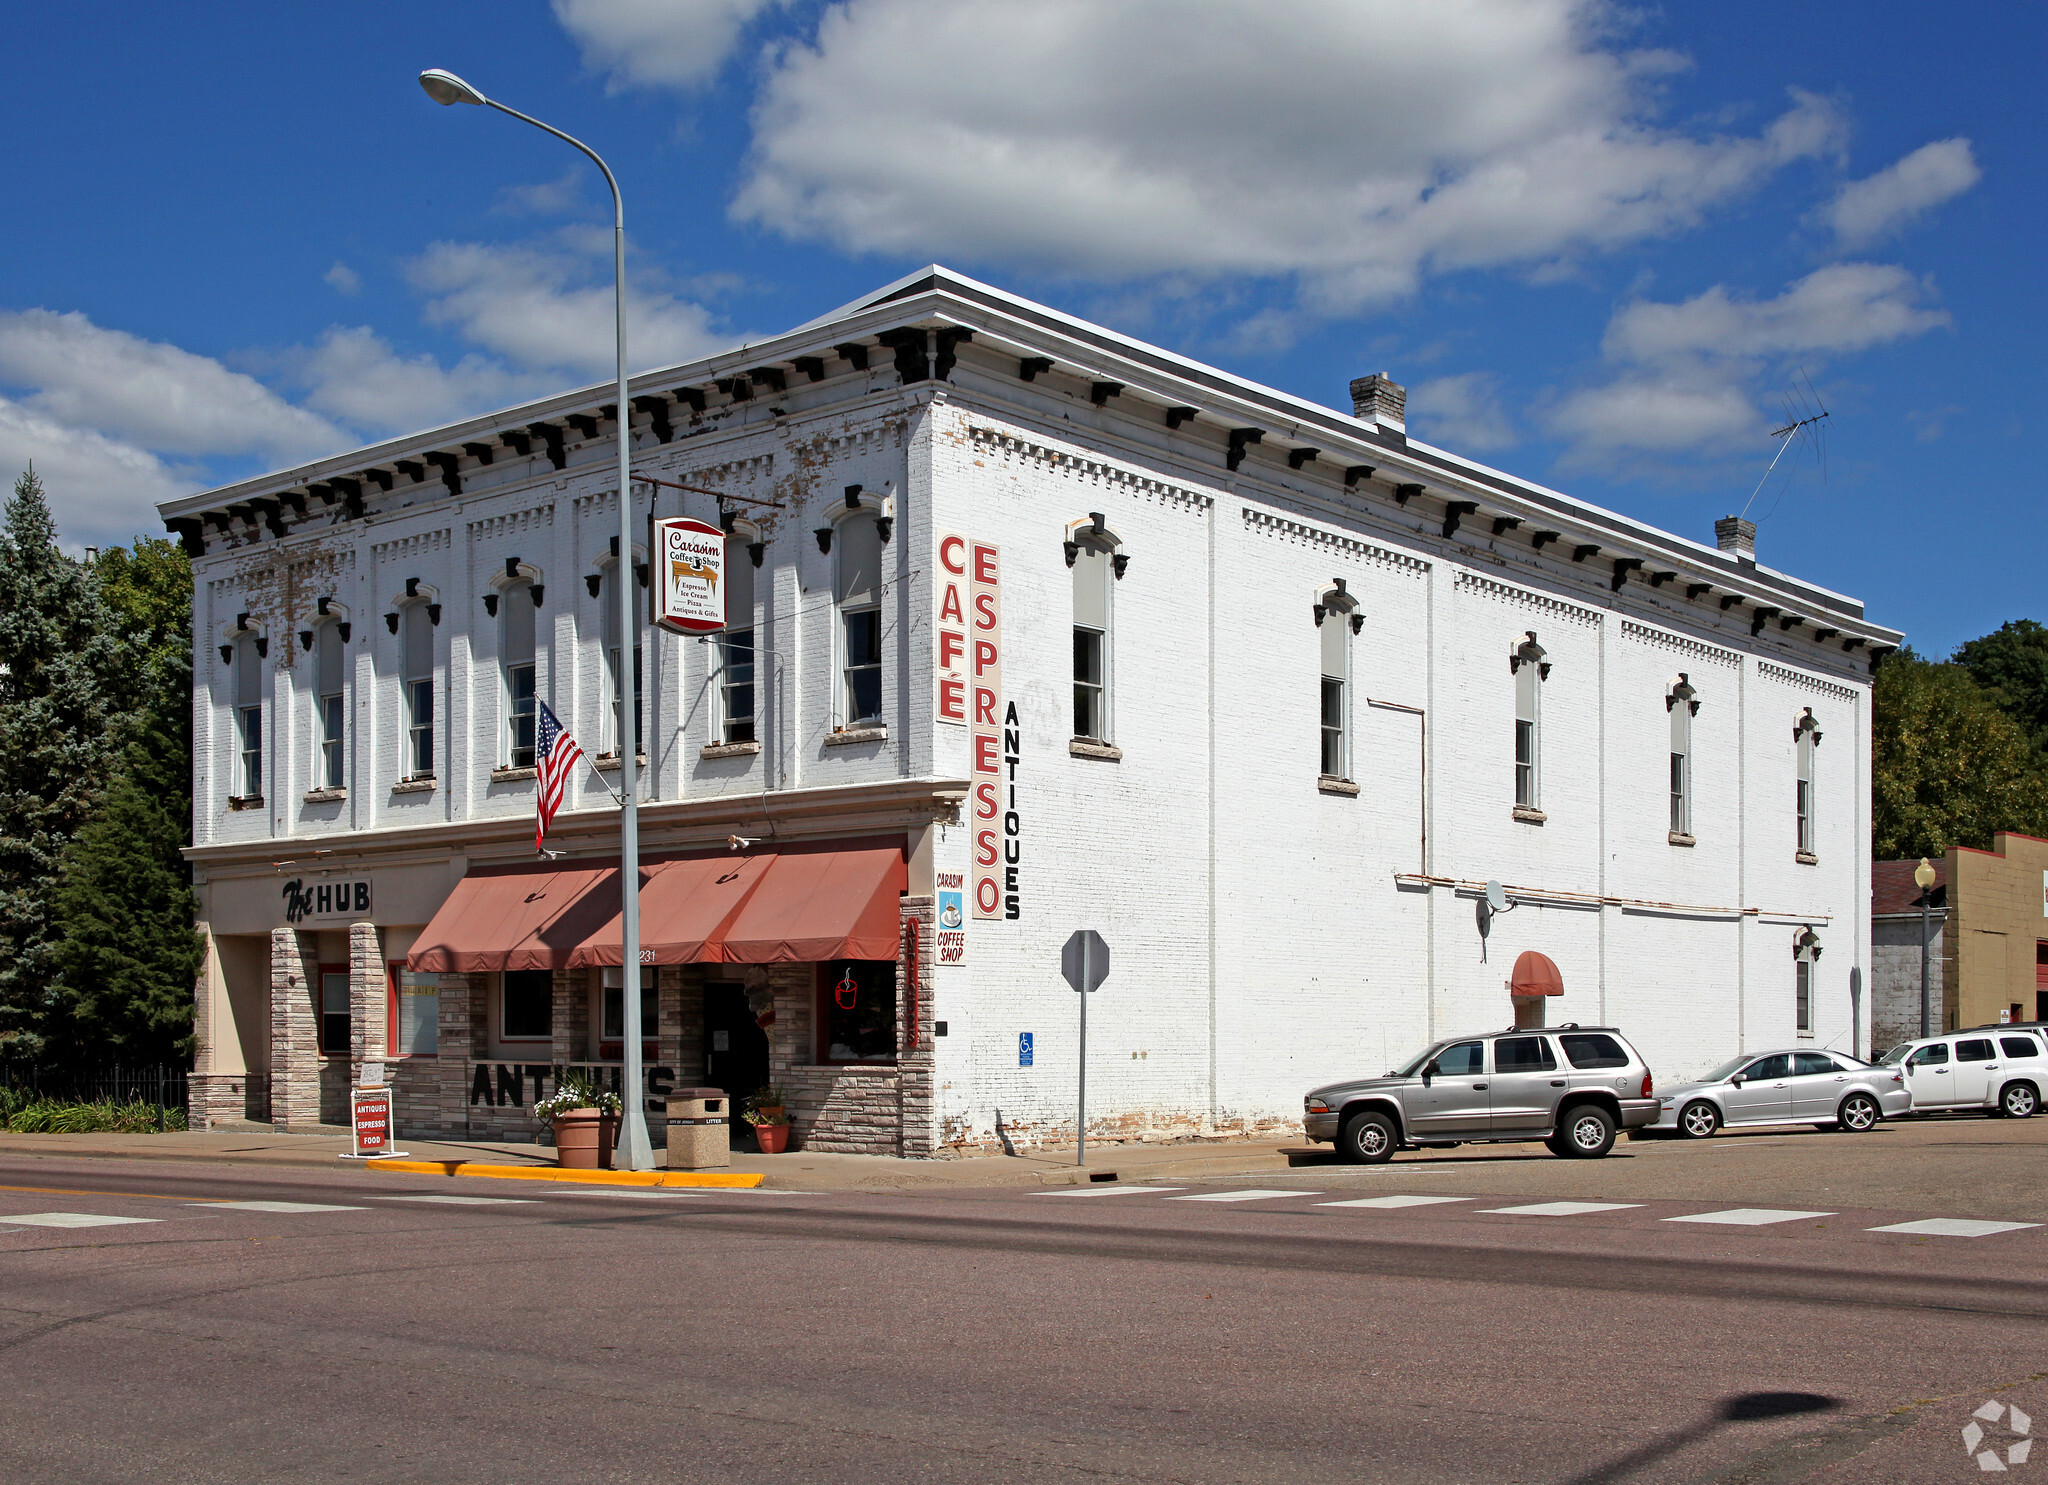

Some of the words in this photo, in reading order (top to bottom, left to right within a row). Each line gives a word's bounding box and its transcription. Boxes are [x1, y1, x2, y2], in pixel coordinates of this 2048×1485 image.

[669, 532, 720, 556] Carasim
[669, 551, 693, 563] Coffee
[702, 557, 720, 569] Shop
[682, 582, 707, 592] Espresso
[687, 599, 702, 607] Pizza
[690, 592, 708, 600] Cream
[672, 605, 697, 615] Antiques
[704, 610, 719, 618] Gifts
[939, 535, 965, 720] CAFÉ
[973, 543, 999, 914] ESPRESSO
[1004, 700, 1020, 920] ANTIQUES
[936, 872, 964, 889] CARASIM
[282, 878, 314, 923] The
[317, 882, 370, 913] HUB
[937, 931, 965, 947] COFFEE
[639, 949, 656, 963] 231
[940, 947, 964, 962] SHOP
[357, 1104, 387, 1114] ANTIQUES
[358, 1120, 386, 1129] ESPRESSO
[363, 1136, 381, 1145] FOOD
